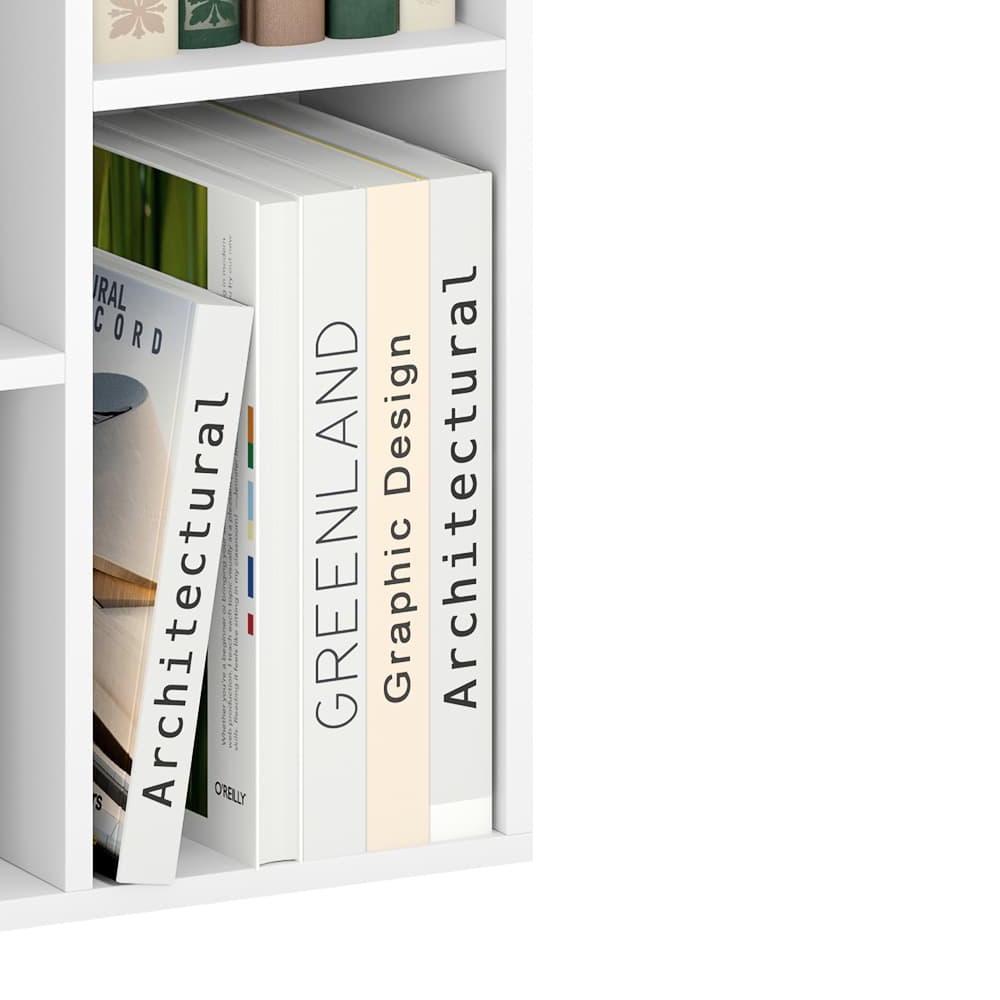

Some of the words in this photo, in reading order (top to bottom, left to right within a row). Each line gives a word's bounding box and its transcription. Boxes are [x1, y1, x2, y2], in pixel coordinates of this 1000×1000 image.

[142, 392, 229, 807] Architectural
[315, 321, 358, 729] GREENLAND
[383, 334, 418, 495] Design
[383, 518, 418, 703] Graphic
[442, 265, 477, 709] Architectural
